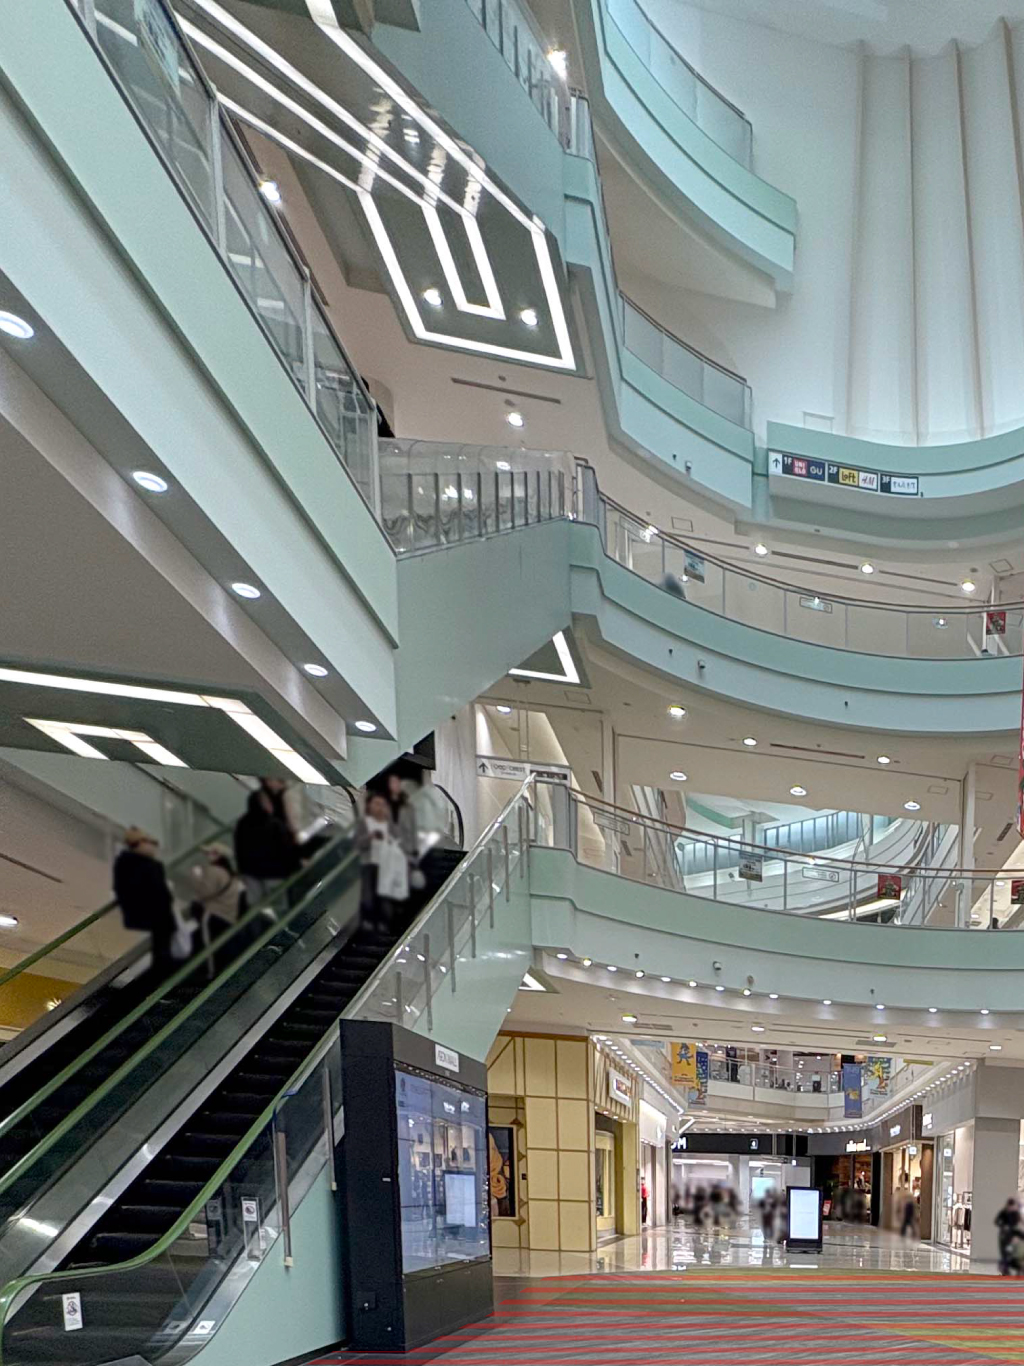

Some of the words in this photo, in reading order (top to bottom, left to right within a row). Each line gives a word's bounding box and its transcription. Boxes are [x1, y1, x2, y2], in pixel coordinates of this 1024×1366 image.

[784, 457, 793, 465] 1F
[810, 466, 823, 475] GU
[829, 466, 838, 474] 2F
[882, 475, 891, 483] 3F
